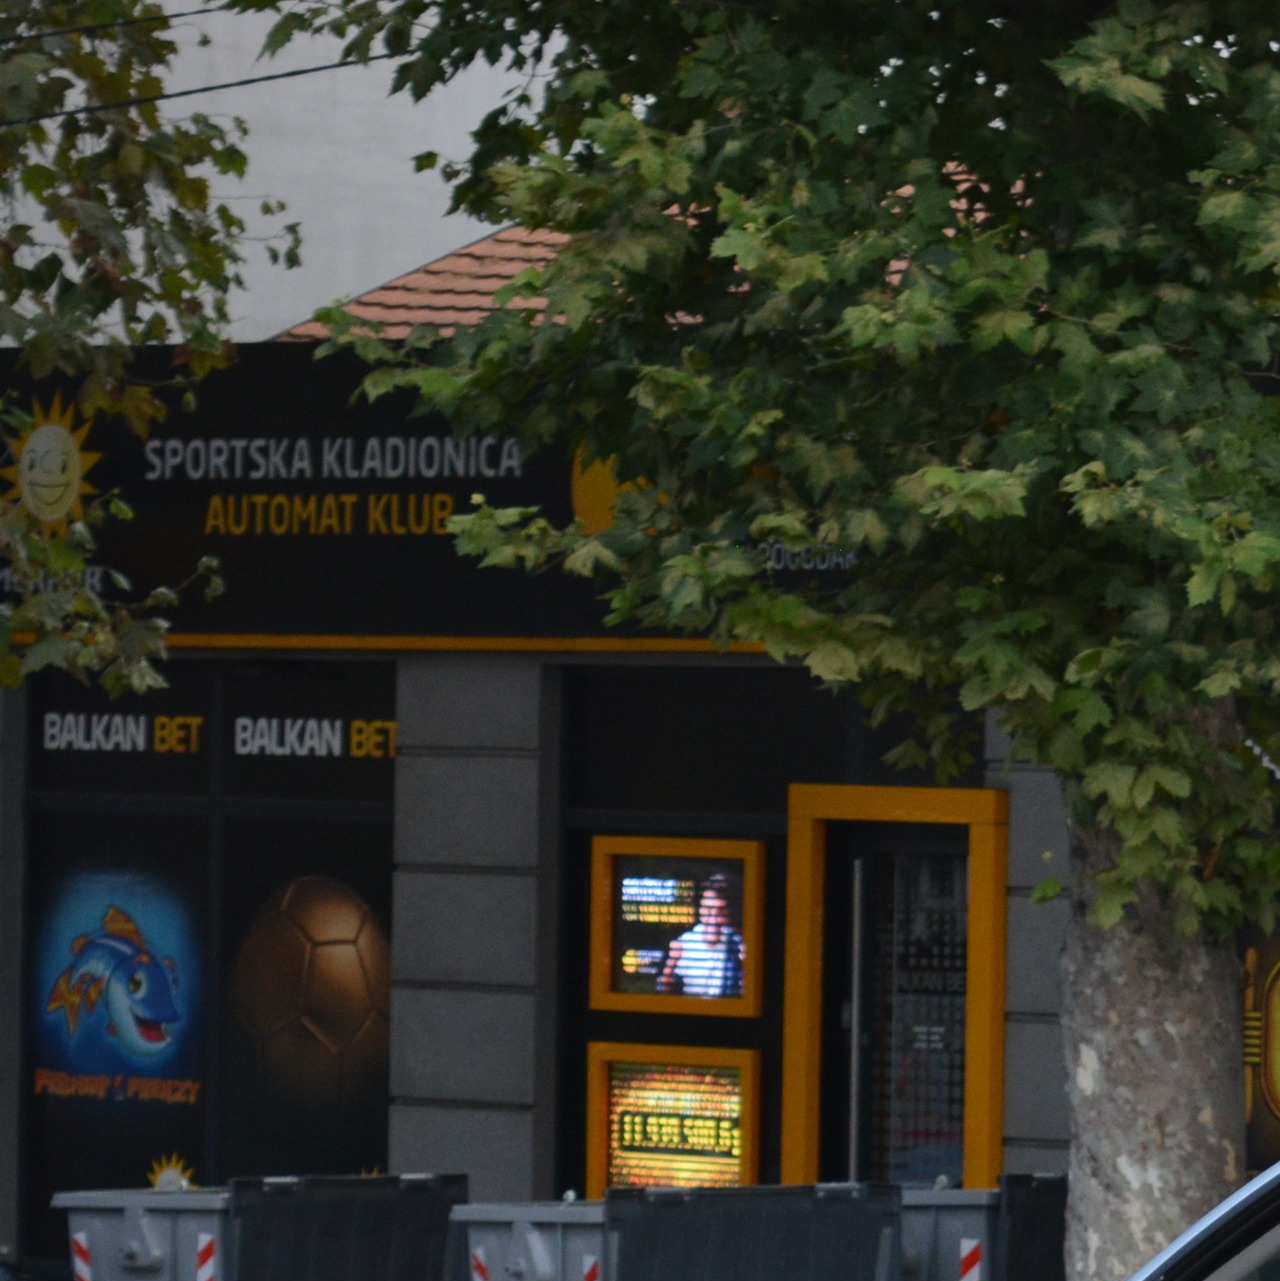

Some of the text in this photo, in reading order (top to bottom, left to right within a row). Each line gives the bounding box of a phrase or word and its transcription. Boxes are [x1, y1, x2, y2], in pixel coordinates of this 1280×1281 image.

[143, 435, 523, 481] SPORTSKA KLADIONICA
[204, 492, 455, 536] AUTOMAT KLUB
[43, 713, 203, 753] BALKAN BET
[235, 716, 397, 758] BALKAN BET
